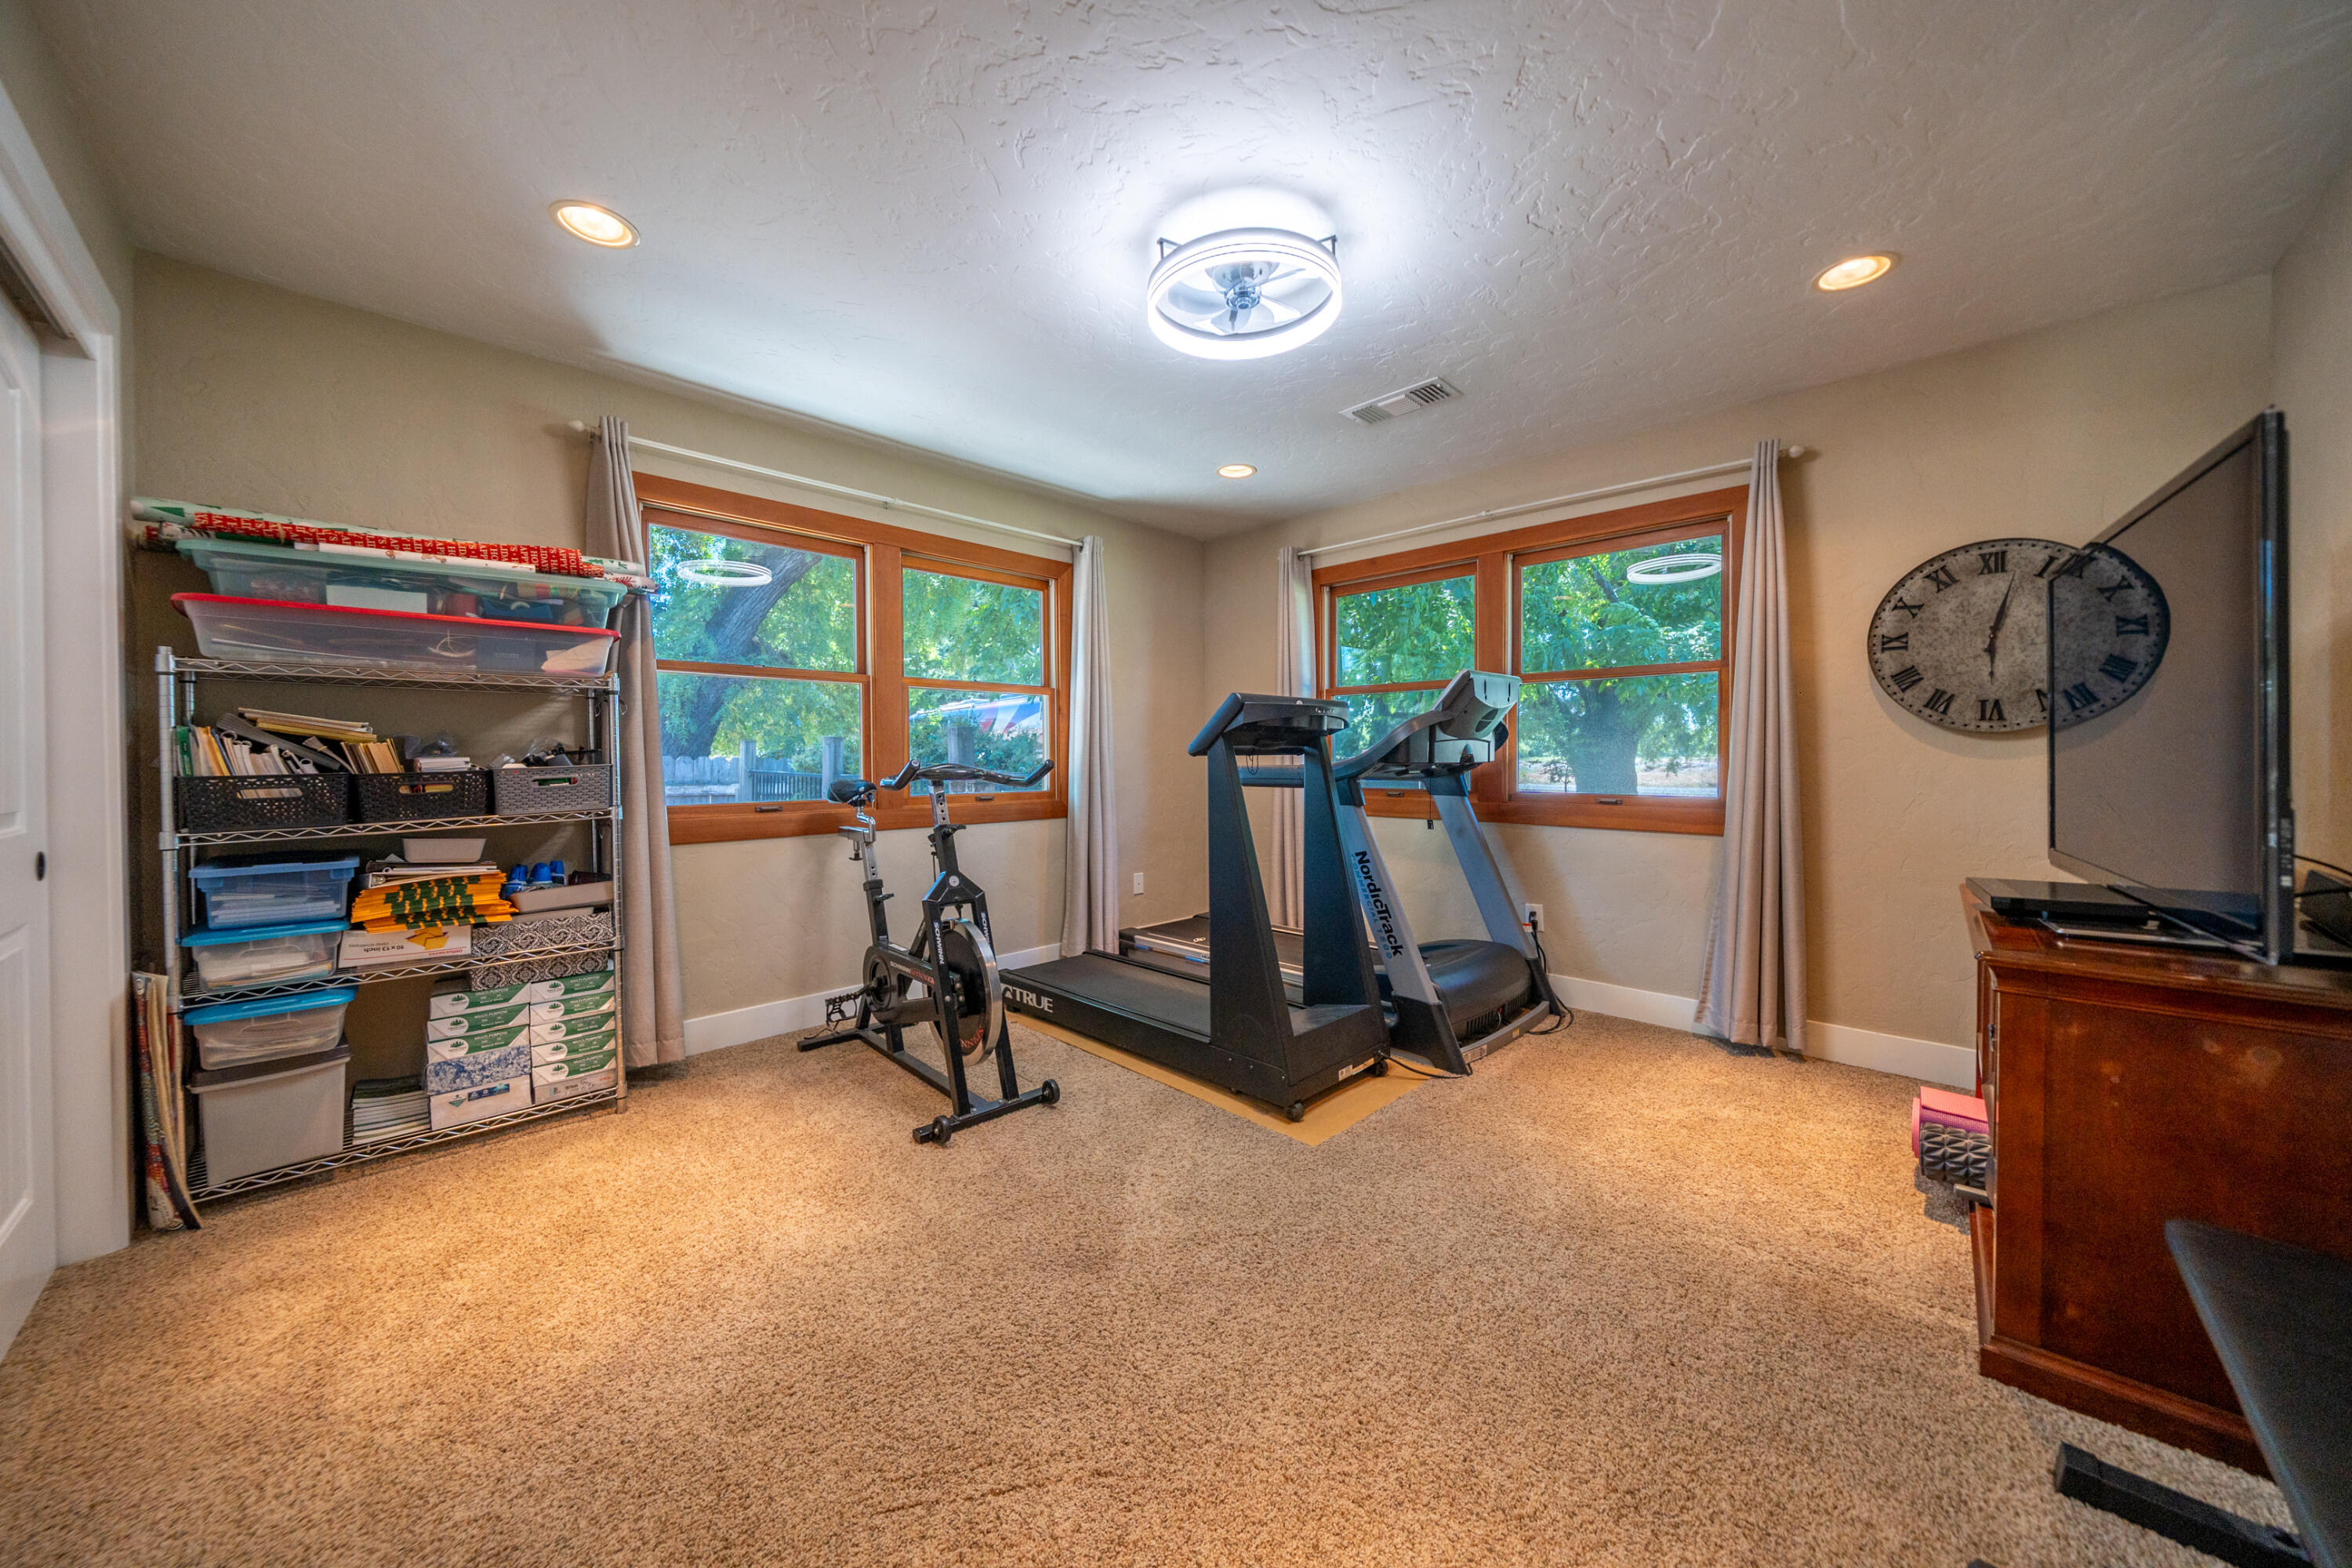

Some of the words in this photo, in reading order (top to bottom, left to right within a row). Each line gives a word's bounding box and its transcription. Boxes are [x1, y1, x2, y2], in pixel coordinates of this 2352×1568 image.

[1978, 551, 2008, 575] XII
[1923, 565, 1960, 593] XI
[1892, 597, 1925, 619] X
[1882, 632, 1908, 652] IX
[1890, 665, 1925, 693] VIII
[1923, 688, 1955, 715] VII
[1978, 699, 2007, 721] VI
[1351, 854, 1379, 924] COMMERCIAL
[1355, 851, 1404, 956] NordicTrack
[934, 921, 945, 965] SCHWINN
[1012, 986, 1054, 1013] TRUE
